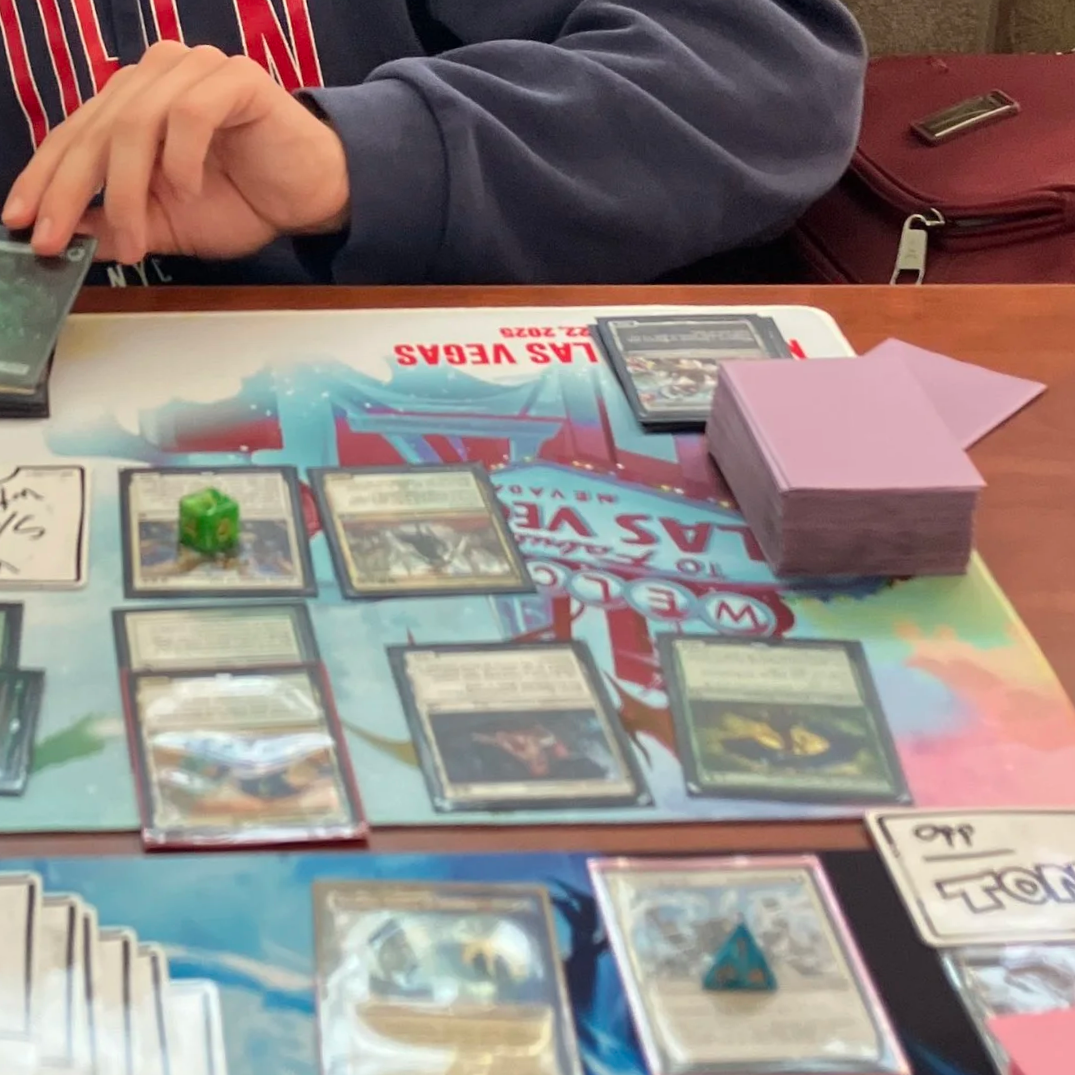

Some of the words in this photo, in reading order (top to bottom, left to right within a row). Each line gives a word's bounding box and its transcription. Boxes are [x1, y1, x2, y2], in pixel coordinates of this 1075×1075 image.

[107, 258, 172, 287] NYC
[499, 327, 554, 339] 2025
[393, 343, 518, 366] VEGAS
[525, 342, 599, 365] LAS
[615, 514, 763, 562] LAS
[677, 559, 725, 578] TO
[532, 567, 769, 634] WELC
